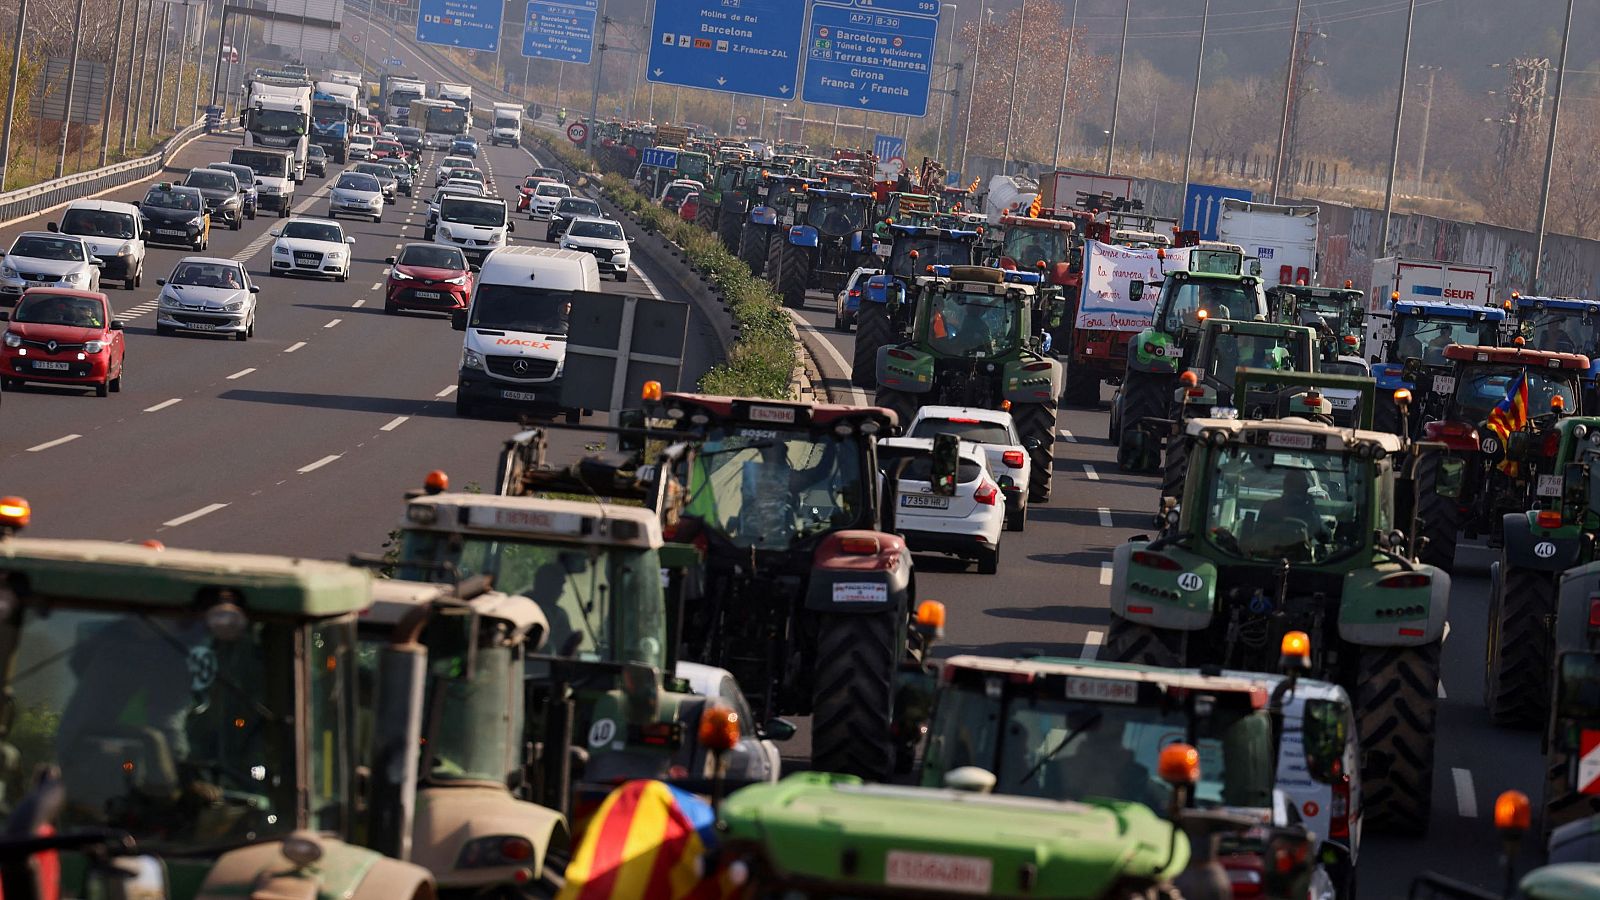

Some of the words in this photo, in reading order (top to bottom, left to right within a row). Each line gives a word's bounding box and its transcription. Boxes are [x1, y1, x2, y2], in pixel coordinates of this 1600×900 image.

[701, 10, 726, 19] Molins
[852, 14, 871, 24] AP-7
[876, 17, 898, 26] B-30
[701, 24, 752, 38] Barcelona
[836, 30, 888, 45] Barcelona
[695, 40, 710, 48] Fira
[836, 42, 862, 51] Túnels
[880, 48, 922, 58] Vallvidrera
[812, 49, 831, 58] C-16
[835, 52, 926, 70] Terrassa-Manresa
[850, 68, 884, 80] Girona
[821, 77, 855, 89] França
[860, 82, 866, 90] /
[871, 84, 909, 96] Francia
[1098, 266, 1107, 276] la
[1444, 288, 1474, 299] SEUR
[496, 338, 551, 350] NACEX
[741, 429, 776, 439] BOSCH
[1483, 439, 1496, 452] 40
[931, 498, 946, 506] HRJ
[1537, 543, 1554, 556] 40
[1182, 574, 1198, 588] 40
